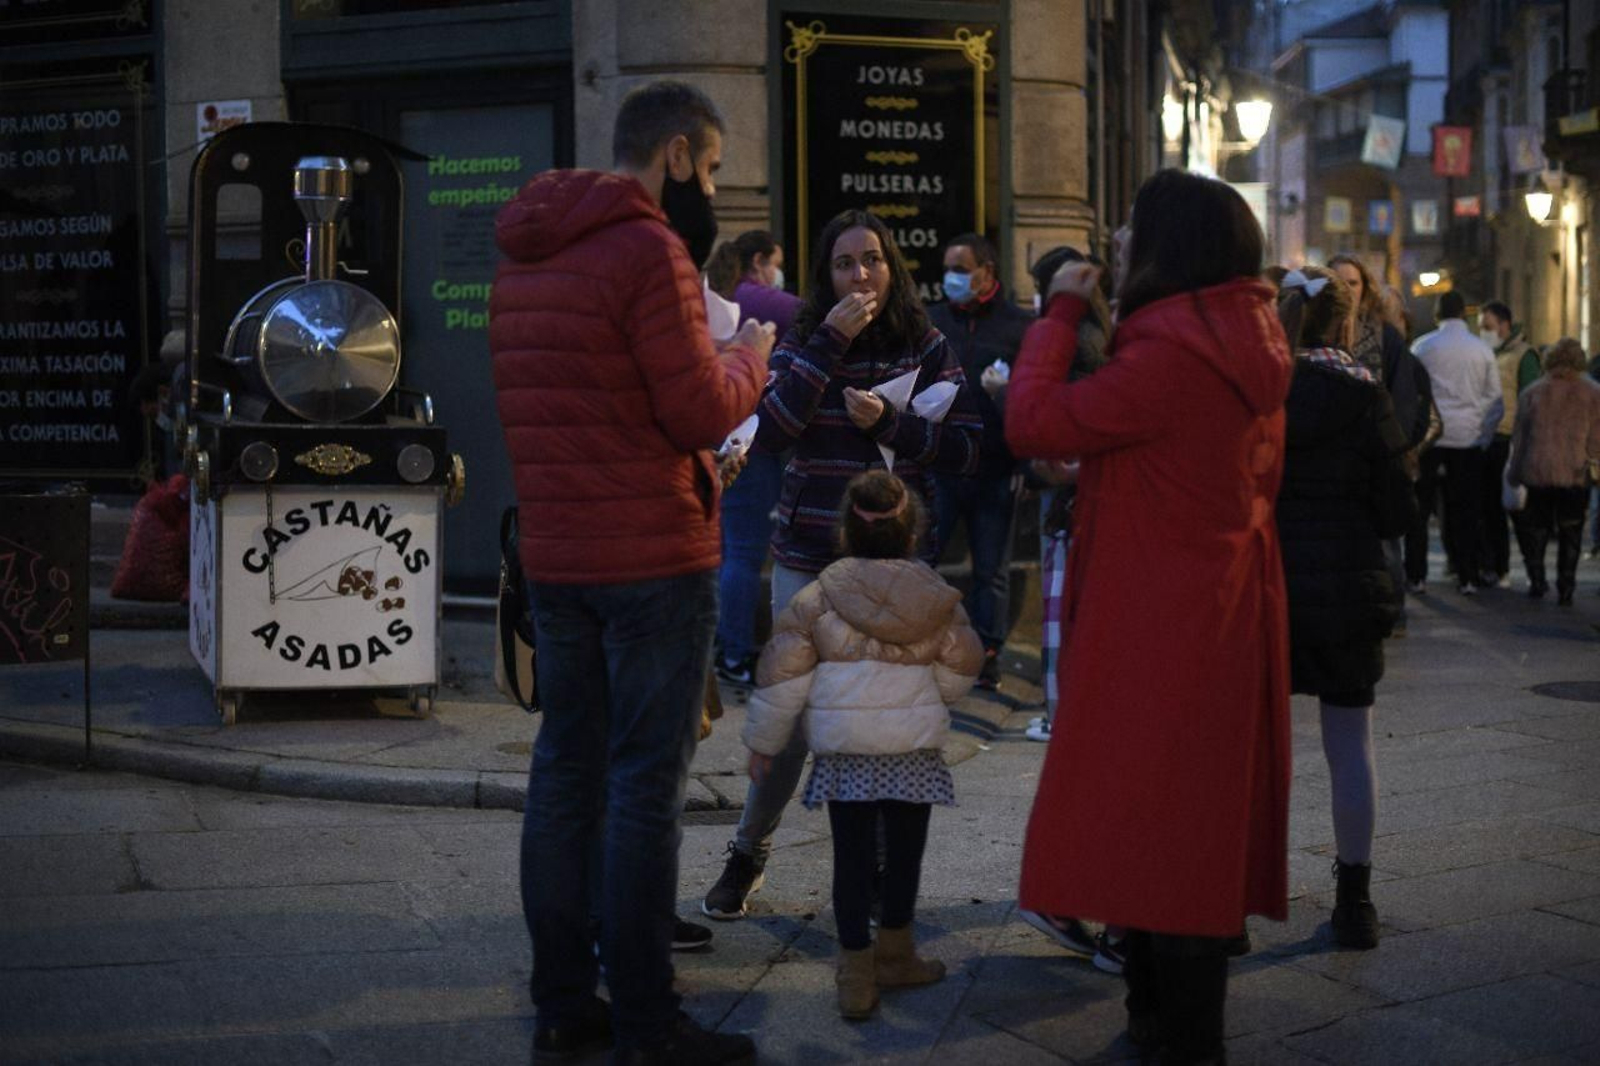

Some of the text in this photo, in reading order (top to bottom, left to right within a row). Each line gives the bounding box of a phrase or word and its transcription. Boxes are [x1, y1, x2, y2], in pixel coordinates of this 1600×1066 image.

[856, 65, 925, 86] JOYAS
[71, 109, 121, 129] TODO
[839, 120, 945, 141] MONEDAS
[0, 144, 129, 168] DE ORO Y PLATA
[428, 154, 521, 177] Hacemos
[841, 174, 944, 195] PULSERAS
[60, 212, 113, 235] SEGÚN
[898, 227, 938, 249] LOS
[0, 249, 114, 272] LSA DE VALOR
[103, 319, 126, 338] LA
[43, 350, 126, 374] TASACIÓN
[25, 390, 87, 408] ENCIMA
[92, 389, 113, 408] DE
[9, 423, 120, 442] COMPETENCIA
[243, 500, 430, 575] CASTAÑAS
[251, 618, 413, 671] ASADAS
